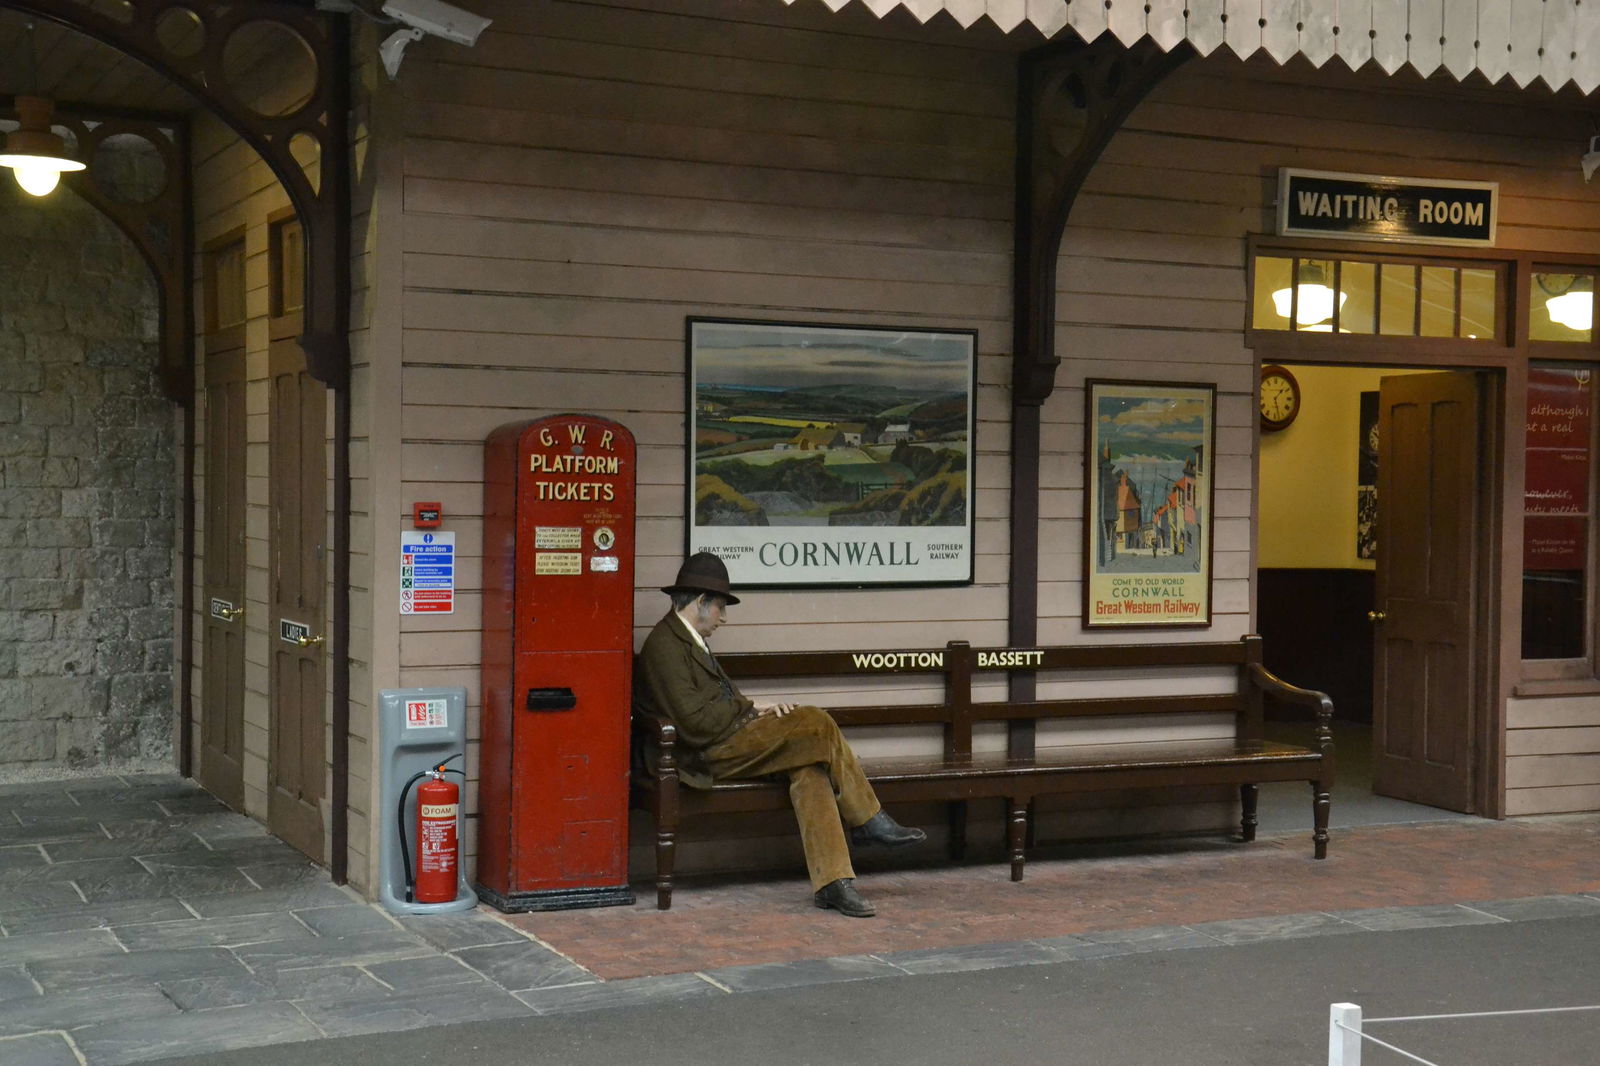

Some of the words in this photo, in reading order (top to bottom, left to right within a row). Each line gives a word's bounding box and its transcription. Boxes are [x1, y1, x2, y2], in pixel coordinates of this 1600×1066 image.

[1298, 191, 1399, 221] WAITING
[1419, 199, 1484, 226] ROOM
[540, 428, 559, 447] G.
[568, 425, 586, 444] W.
[600, 429, 614, 451] R.
[530, 454, 618, 474] PLATFORM
[536, 481, 614, 501] TICKETS
[410, 545, 424, 553] Fire
[425, 545, 447, 553] action
[759, 541, 919, 567] CORNWALL
[927, 543, 963, 551] SOUTHERN
[930, 552, 959, 560] RAILWAY
[1145, 578, 1159, 586] OLD
[1112, 587, 1185, 598] CORNWALL
[1096, 600, 1122, 615] Great
[1124, 600, 1161, 614] Western
[1164, 599, 1200, 616] Railway
[852, 652, 944, 668] WOOTTON
[977, 651, 1045, 667] BASSETT
[430, 807, 452, 815] FOAM
